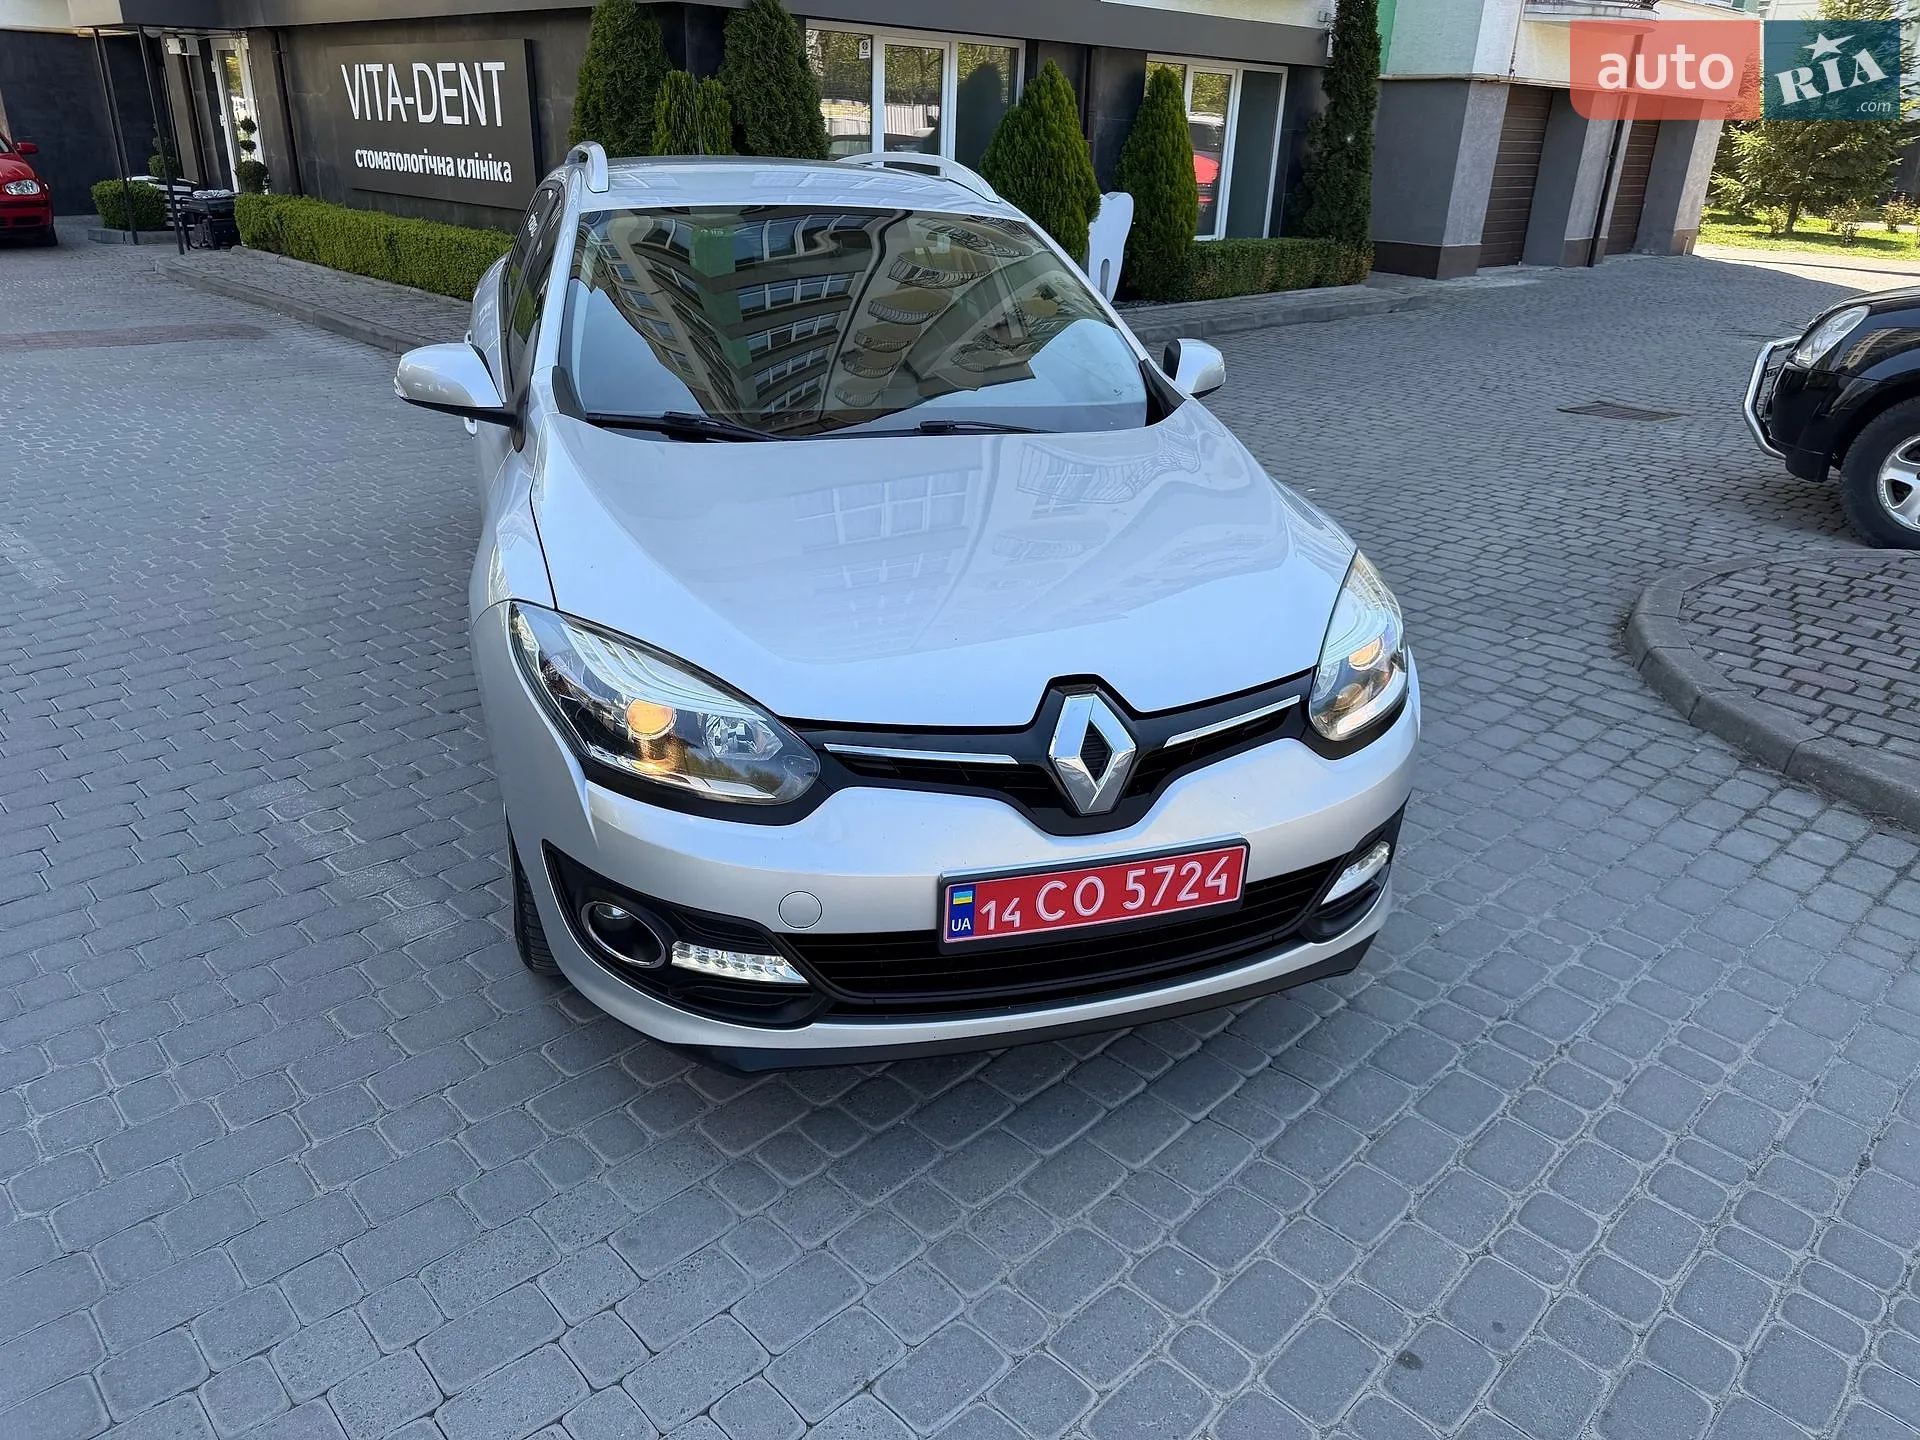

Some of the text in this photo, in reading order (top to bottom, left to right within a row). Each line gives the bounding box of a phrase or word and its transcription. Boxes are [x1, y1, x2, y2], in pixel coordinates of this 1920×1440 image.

[341, 62, 506, 127] VITA-DENT
[355, 148, 512, 183] стоматологічна клініка
[979, 856, 1230, 930] 14 CO 5724
[951, 915, 972, 932] UA
